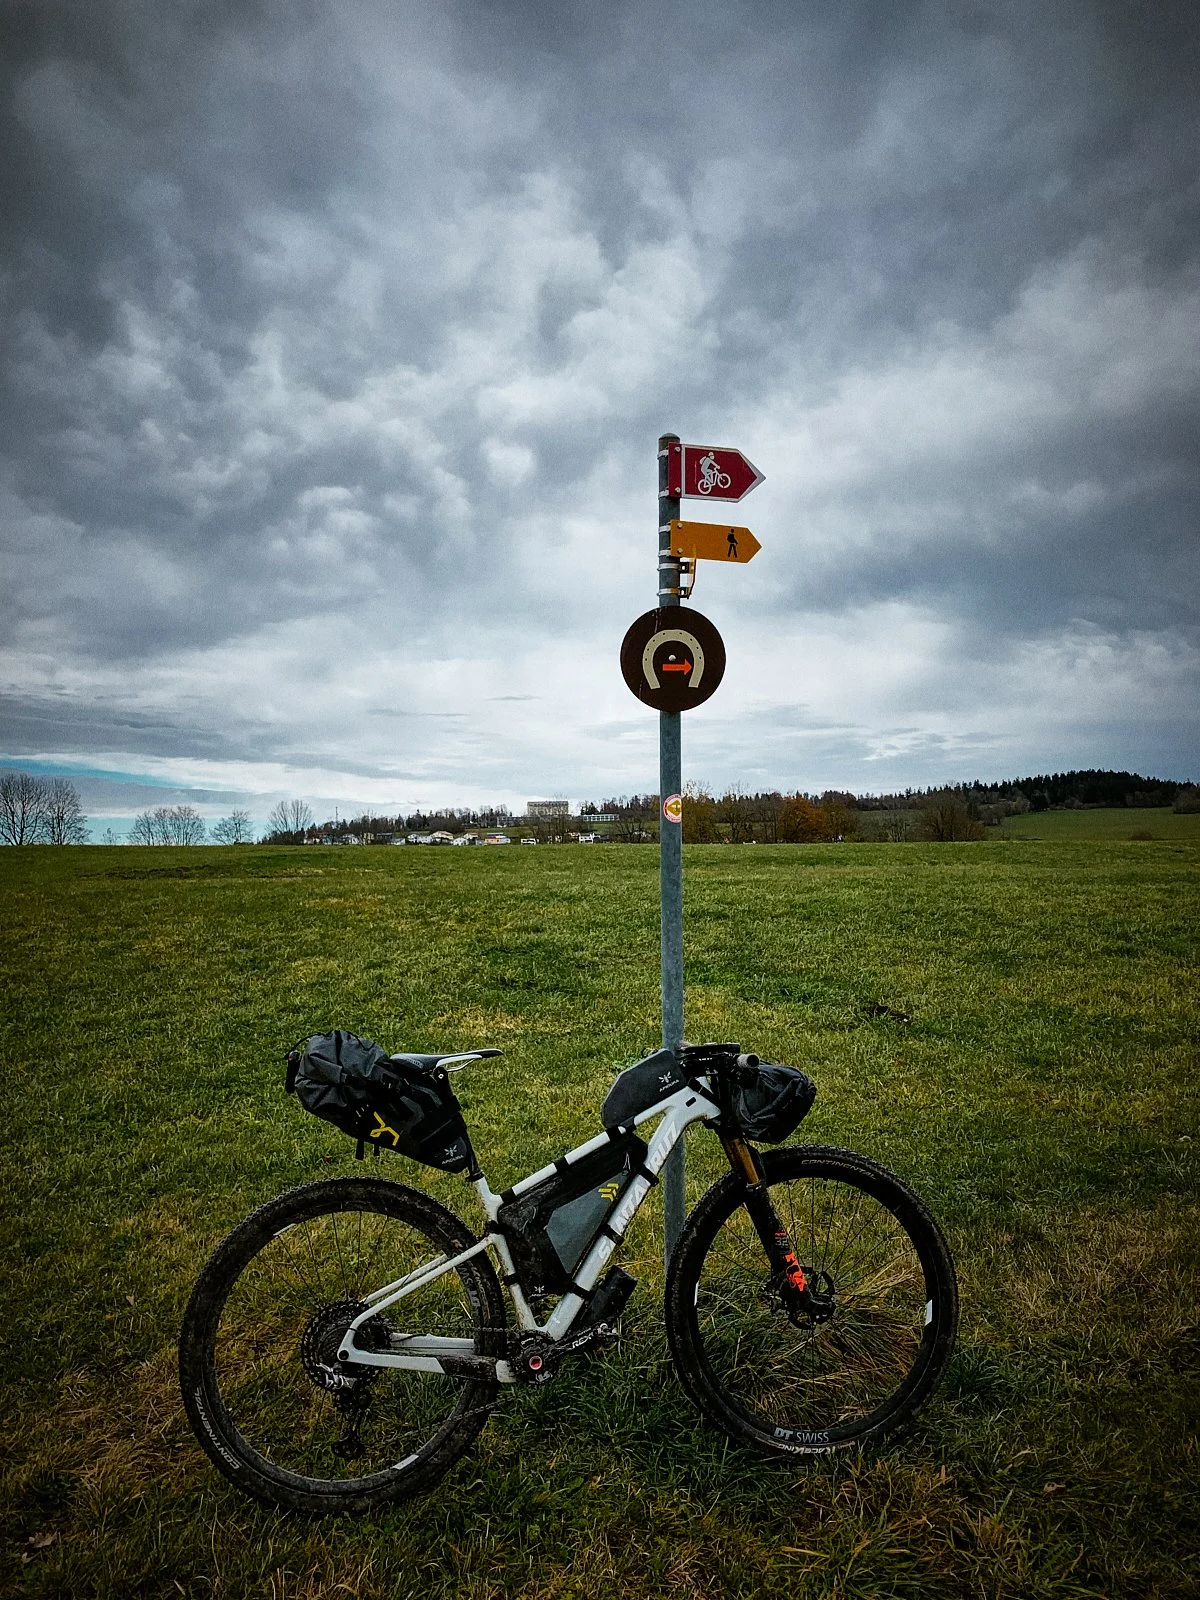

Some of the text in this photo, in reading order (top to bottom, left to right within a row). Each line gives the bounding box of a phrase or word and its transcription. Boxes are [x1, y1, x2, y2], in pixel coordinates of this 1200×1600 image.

[646, 1121, 678, 1175] RUZ
[801, 1159, 876, 1180] CONTINENTAL
[194, 1386, 240, 1470] CONTINENTAL
[773, 1427, 830, 1444] DT SWISS
